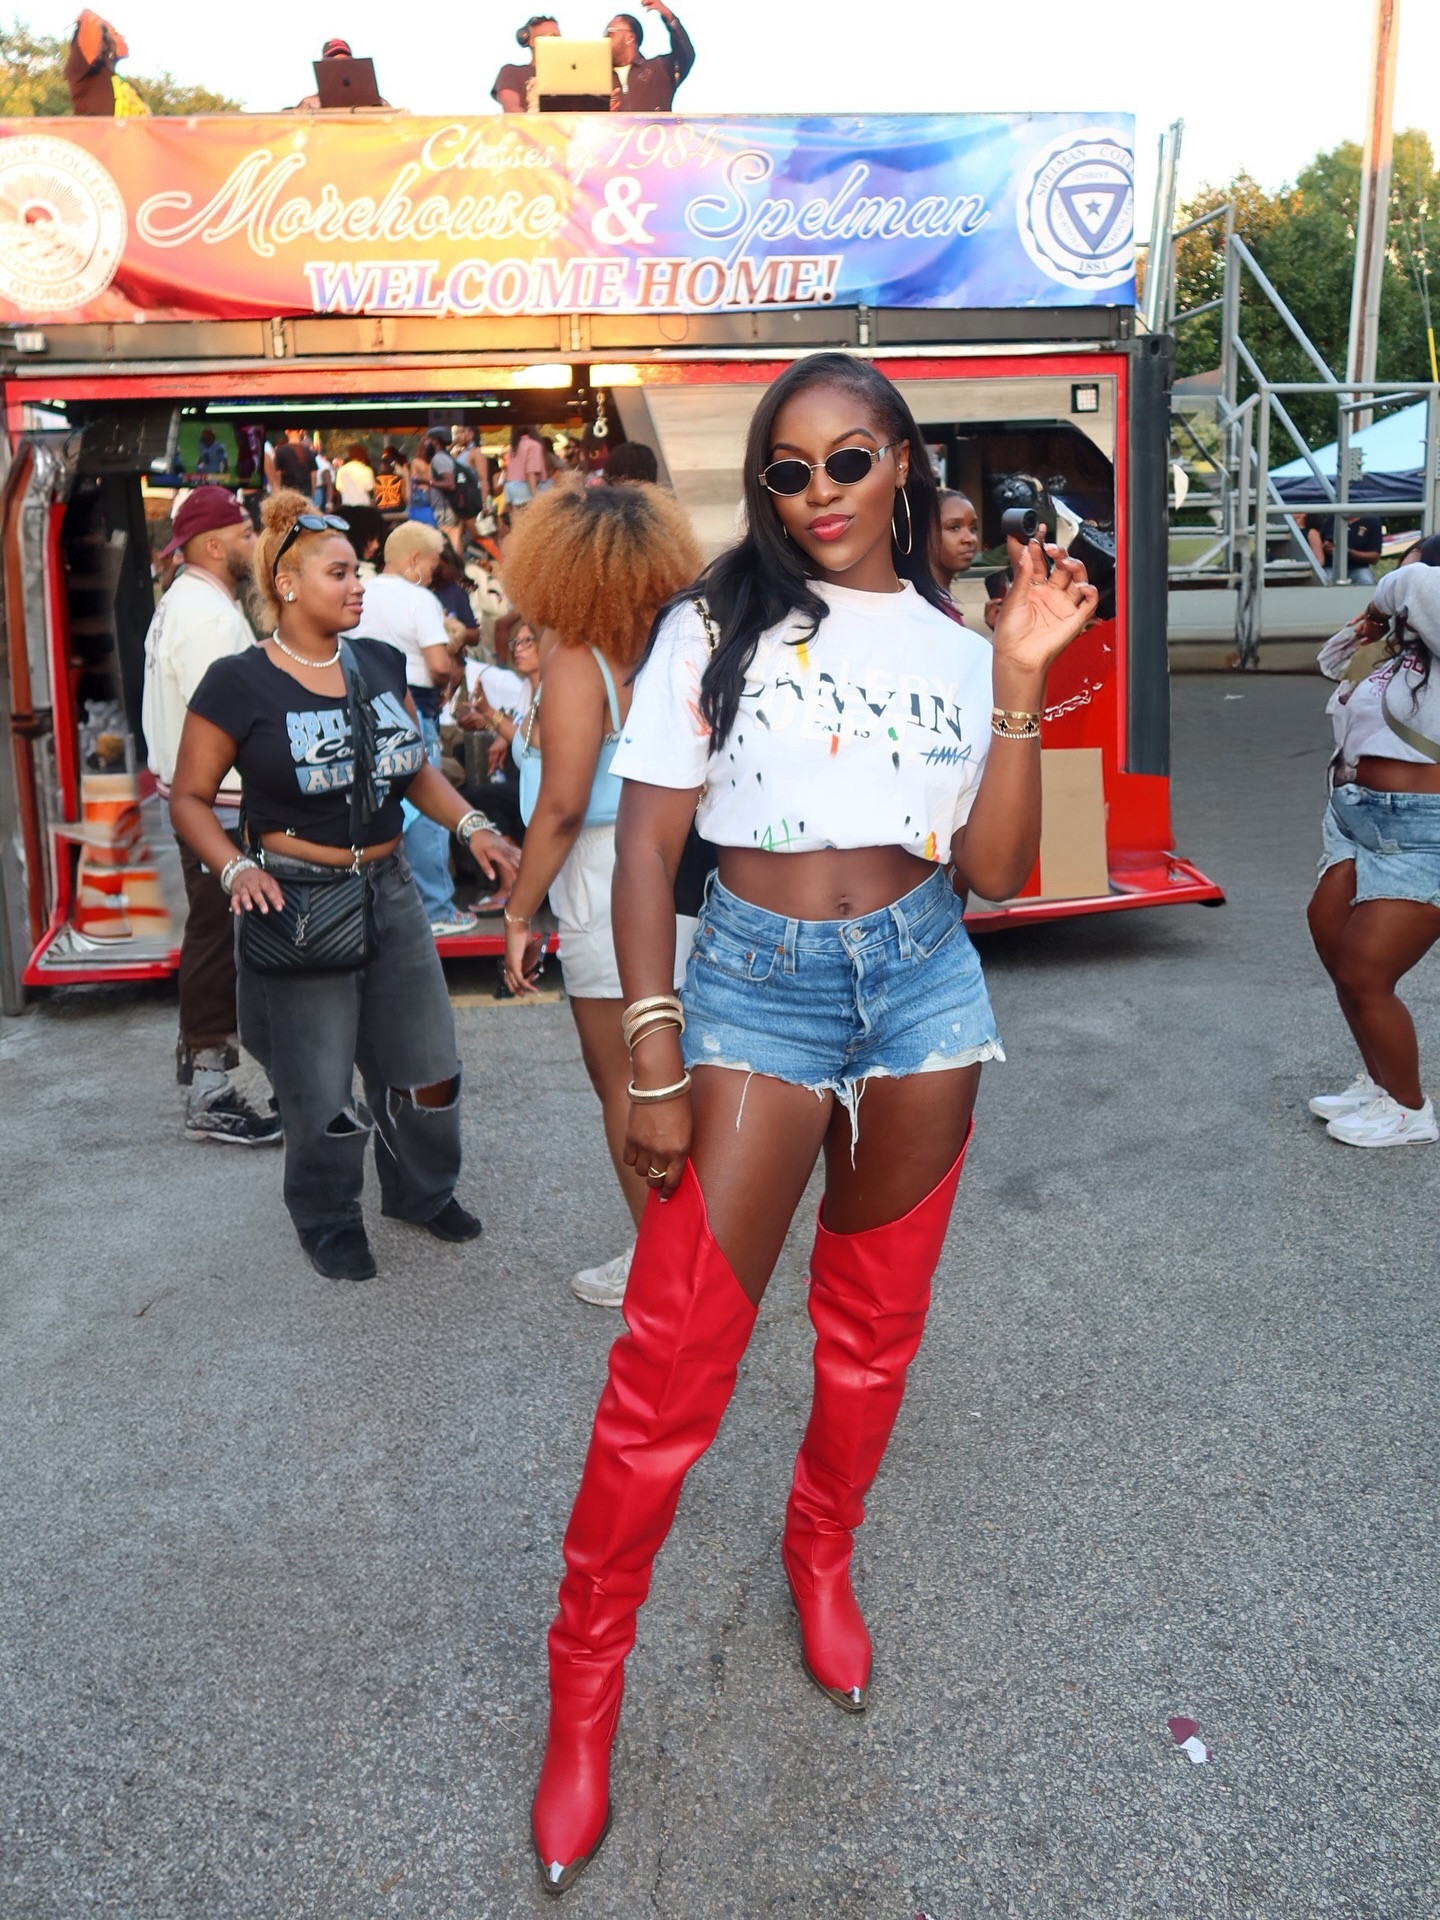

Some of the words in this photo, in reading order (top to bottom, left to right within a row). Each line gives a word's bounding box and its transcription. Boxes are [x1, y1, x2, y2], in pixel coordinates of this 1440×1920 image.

[421, 123, 555, 172] Classes
[604, 120, 724, 170] 1984
[1036, 146, 1088, 198] SPELMAN
[136, 148, 563, 258] Morehouse
[591, 175, 658, 245] &
[684, 150, 993, 271] Spelman
[303, 254, 630, 316] WELCOME
[639, 252, 844, 311] HOME!
[1078, 259, 1109, 272] 1881
[286, 691, 418, 762] SPELAN
[305, 729, 417, 765] Coege
